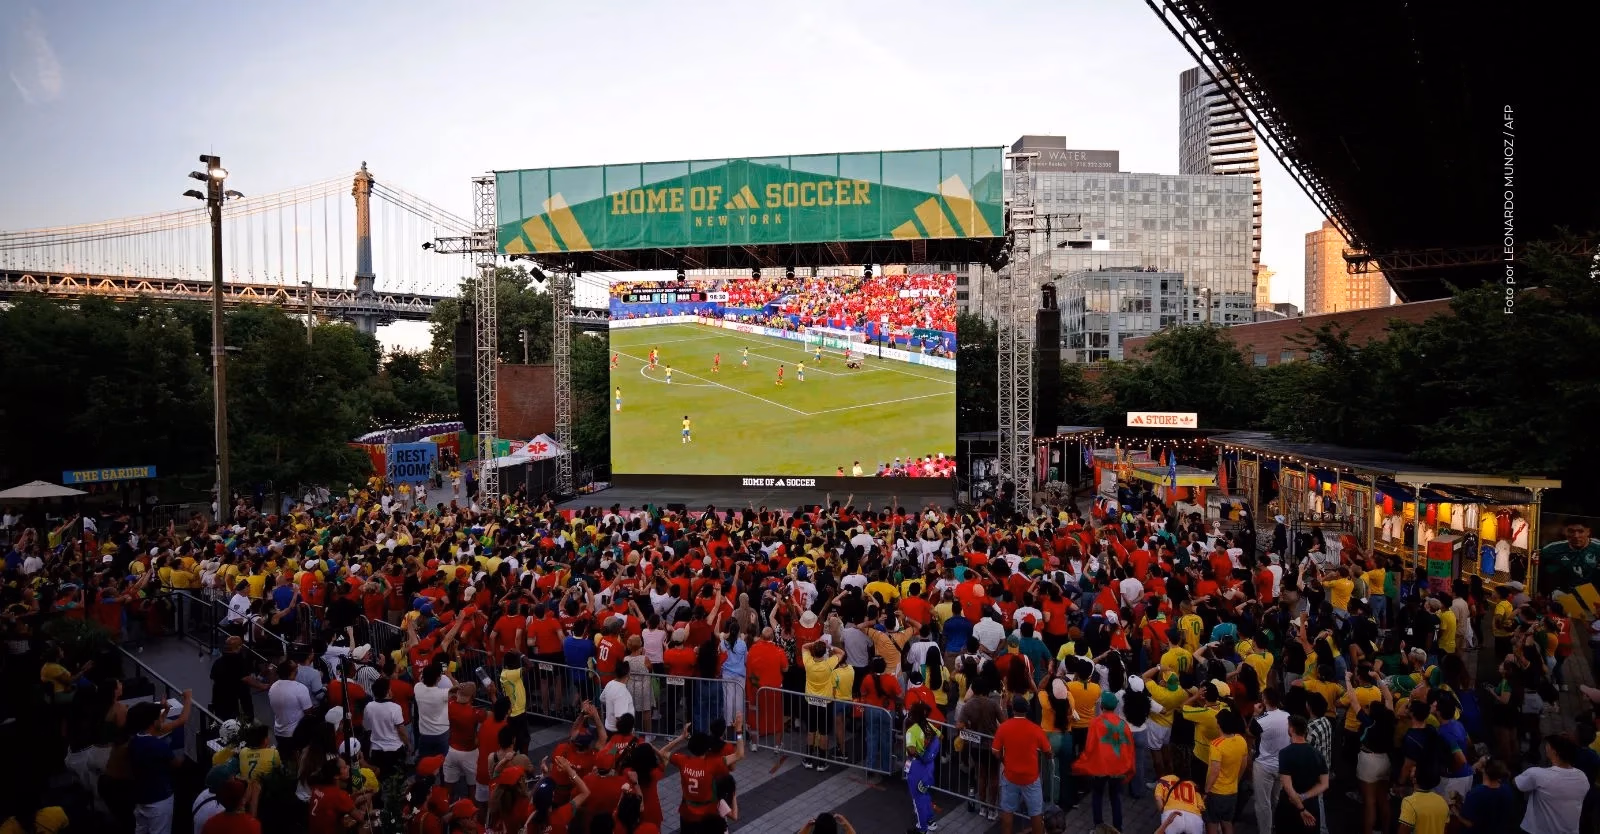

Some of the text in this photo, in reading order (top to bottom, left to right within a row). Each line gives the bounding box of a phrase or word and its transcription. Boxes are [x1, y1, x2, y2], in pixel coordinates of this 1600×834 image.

[1049, 152, 1087, 160] WATER
[611, 180, 872, 215] HOME OF SOCCER
[695, 213, 782, 227] NEW YORK
[1146, 415, 1178, 425] STORE
[397, 449, 426, 462] REST
[73, 467, 148, 482] THE GARDEN
[1191, 621, 1200, 635] 10
[600, 645, 609, 661] 10
[248, 761, 257, 777] 7
[684, 767, 704, 777] HAKIMI
[688, 778, 699, 794] 2
[1172, 781, 1195, 804] 10
